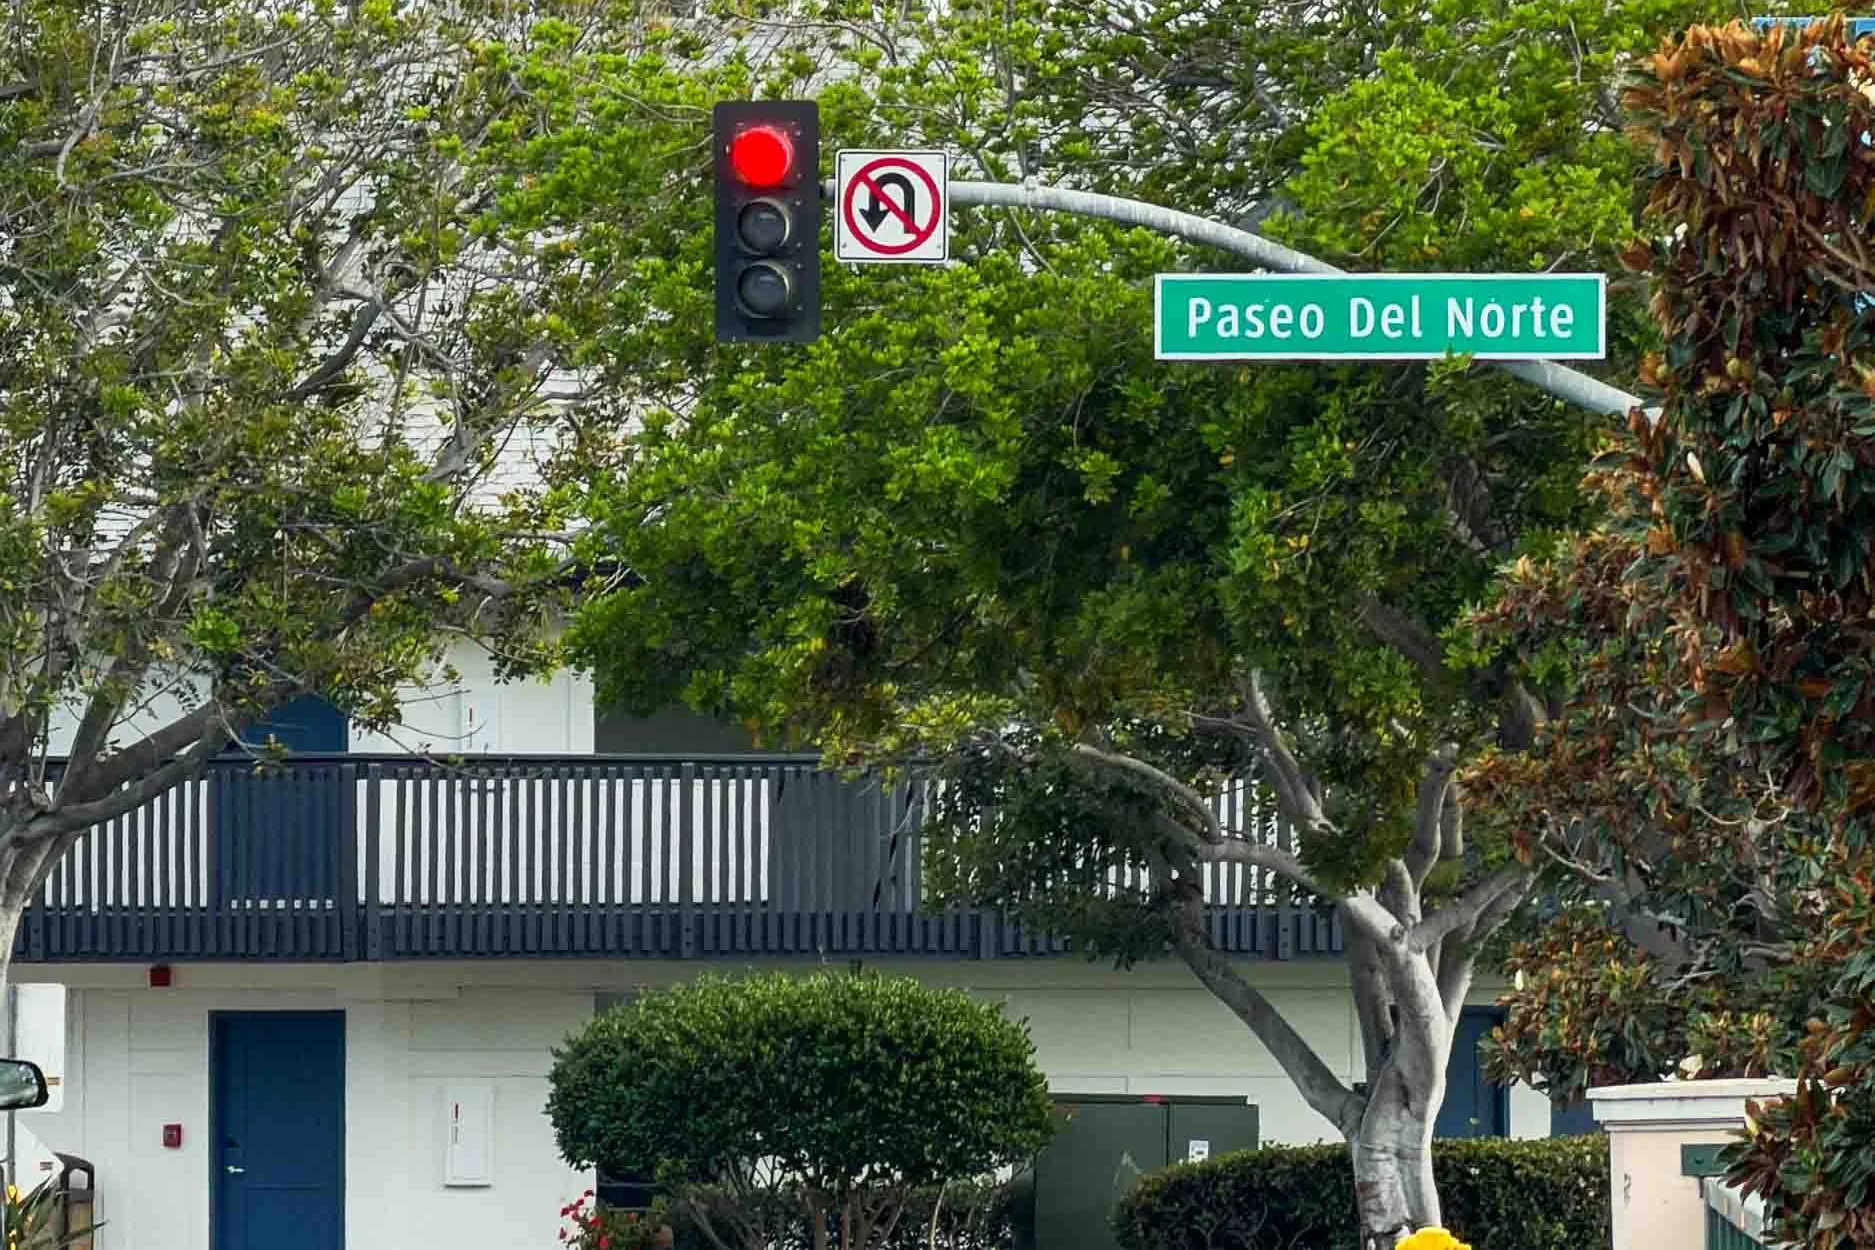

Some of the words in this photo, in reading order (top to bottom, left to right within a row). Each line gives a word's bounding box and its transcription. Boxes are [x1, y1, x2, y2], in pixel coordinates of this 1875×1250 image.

[1187, 296, 1324, 338] Paseo
[1350, 295, 1422, 338] Del
[1447, 297, 1573, 338] Norte
